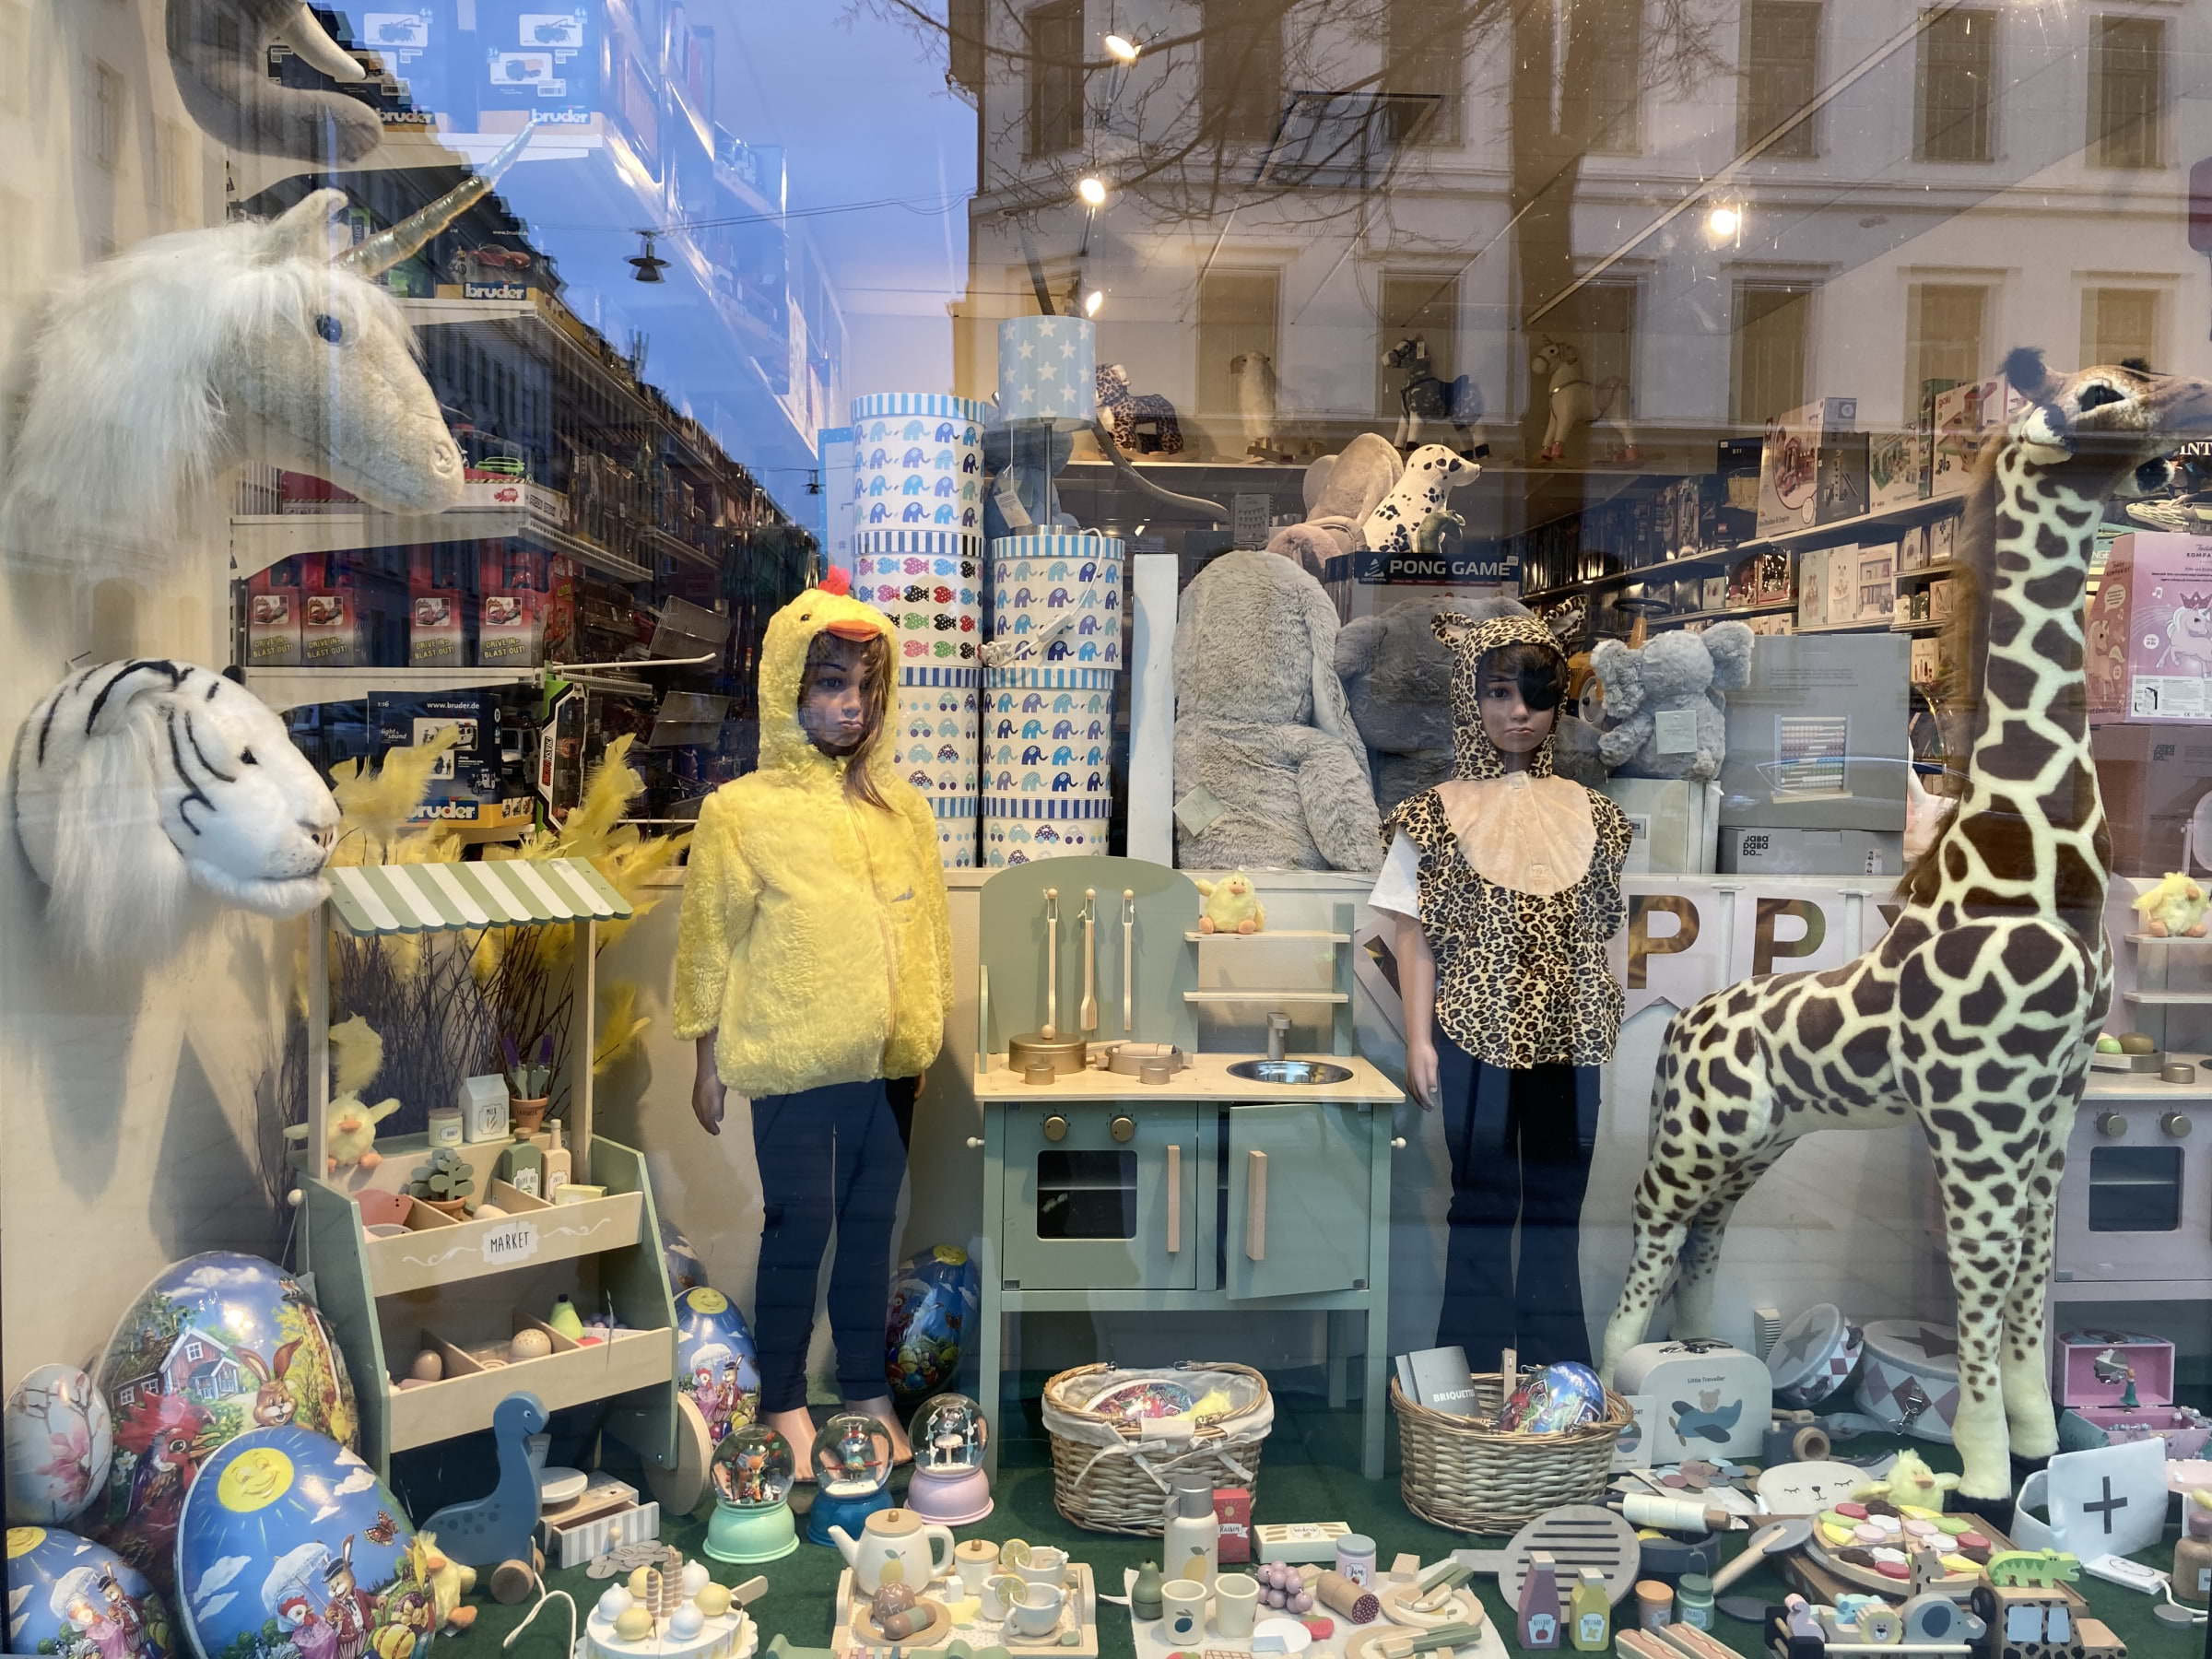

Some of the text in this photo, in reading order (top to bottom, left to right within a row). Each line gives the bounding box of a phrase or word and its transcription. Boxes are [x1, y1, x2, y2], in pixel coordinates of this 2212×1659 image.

[487, 48, 499, 57] 3+
[376, 108, 433, 124] bruder
[531, 109, 590, 124] bruder
[465, 283, 524, 300] bruder
[1389, 559, 1512, 576] PONG GAME
[309, 639, 330, 649] DRIVE
[416, 640, 436, 650] DRIVE
[486, 639, 507, 649] DRIVE
[307, 649, 329, 659] BLAST
[415, 650, 436, 660] BLAST
[484, 648, 507, 659] BLAST
[427, 701, 479, 710] www.bruder.de
[490, 1231, 530, 1253] MARKET
[1350, 1566, 1365, 1577] Jam
